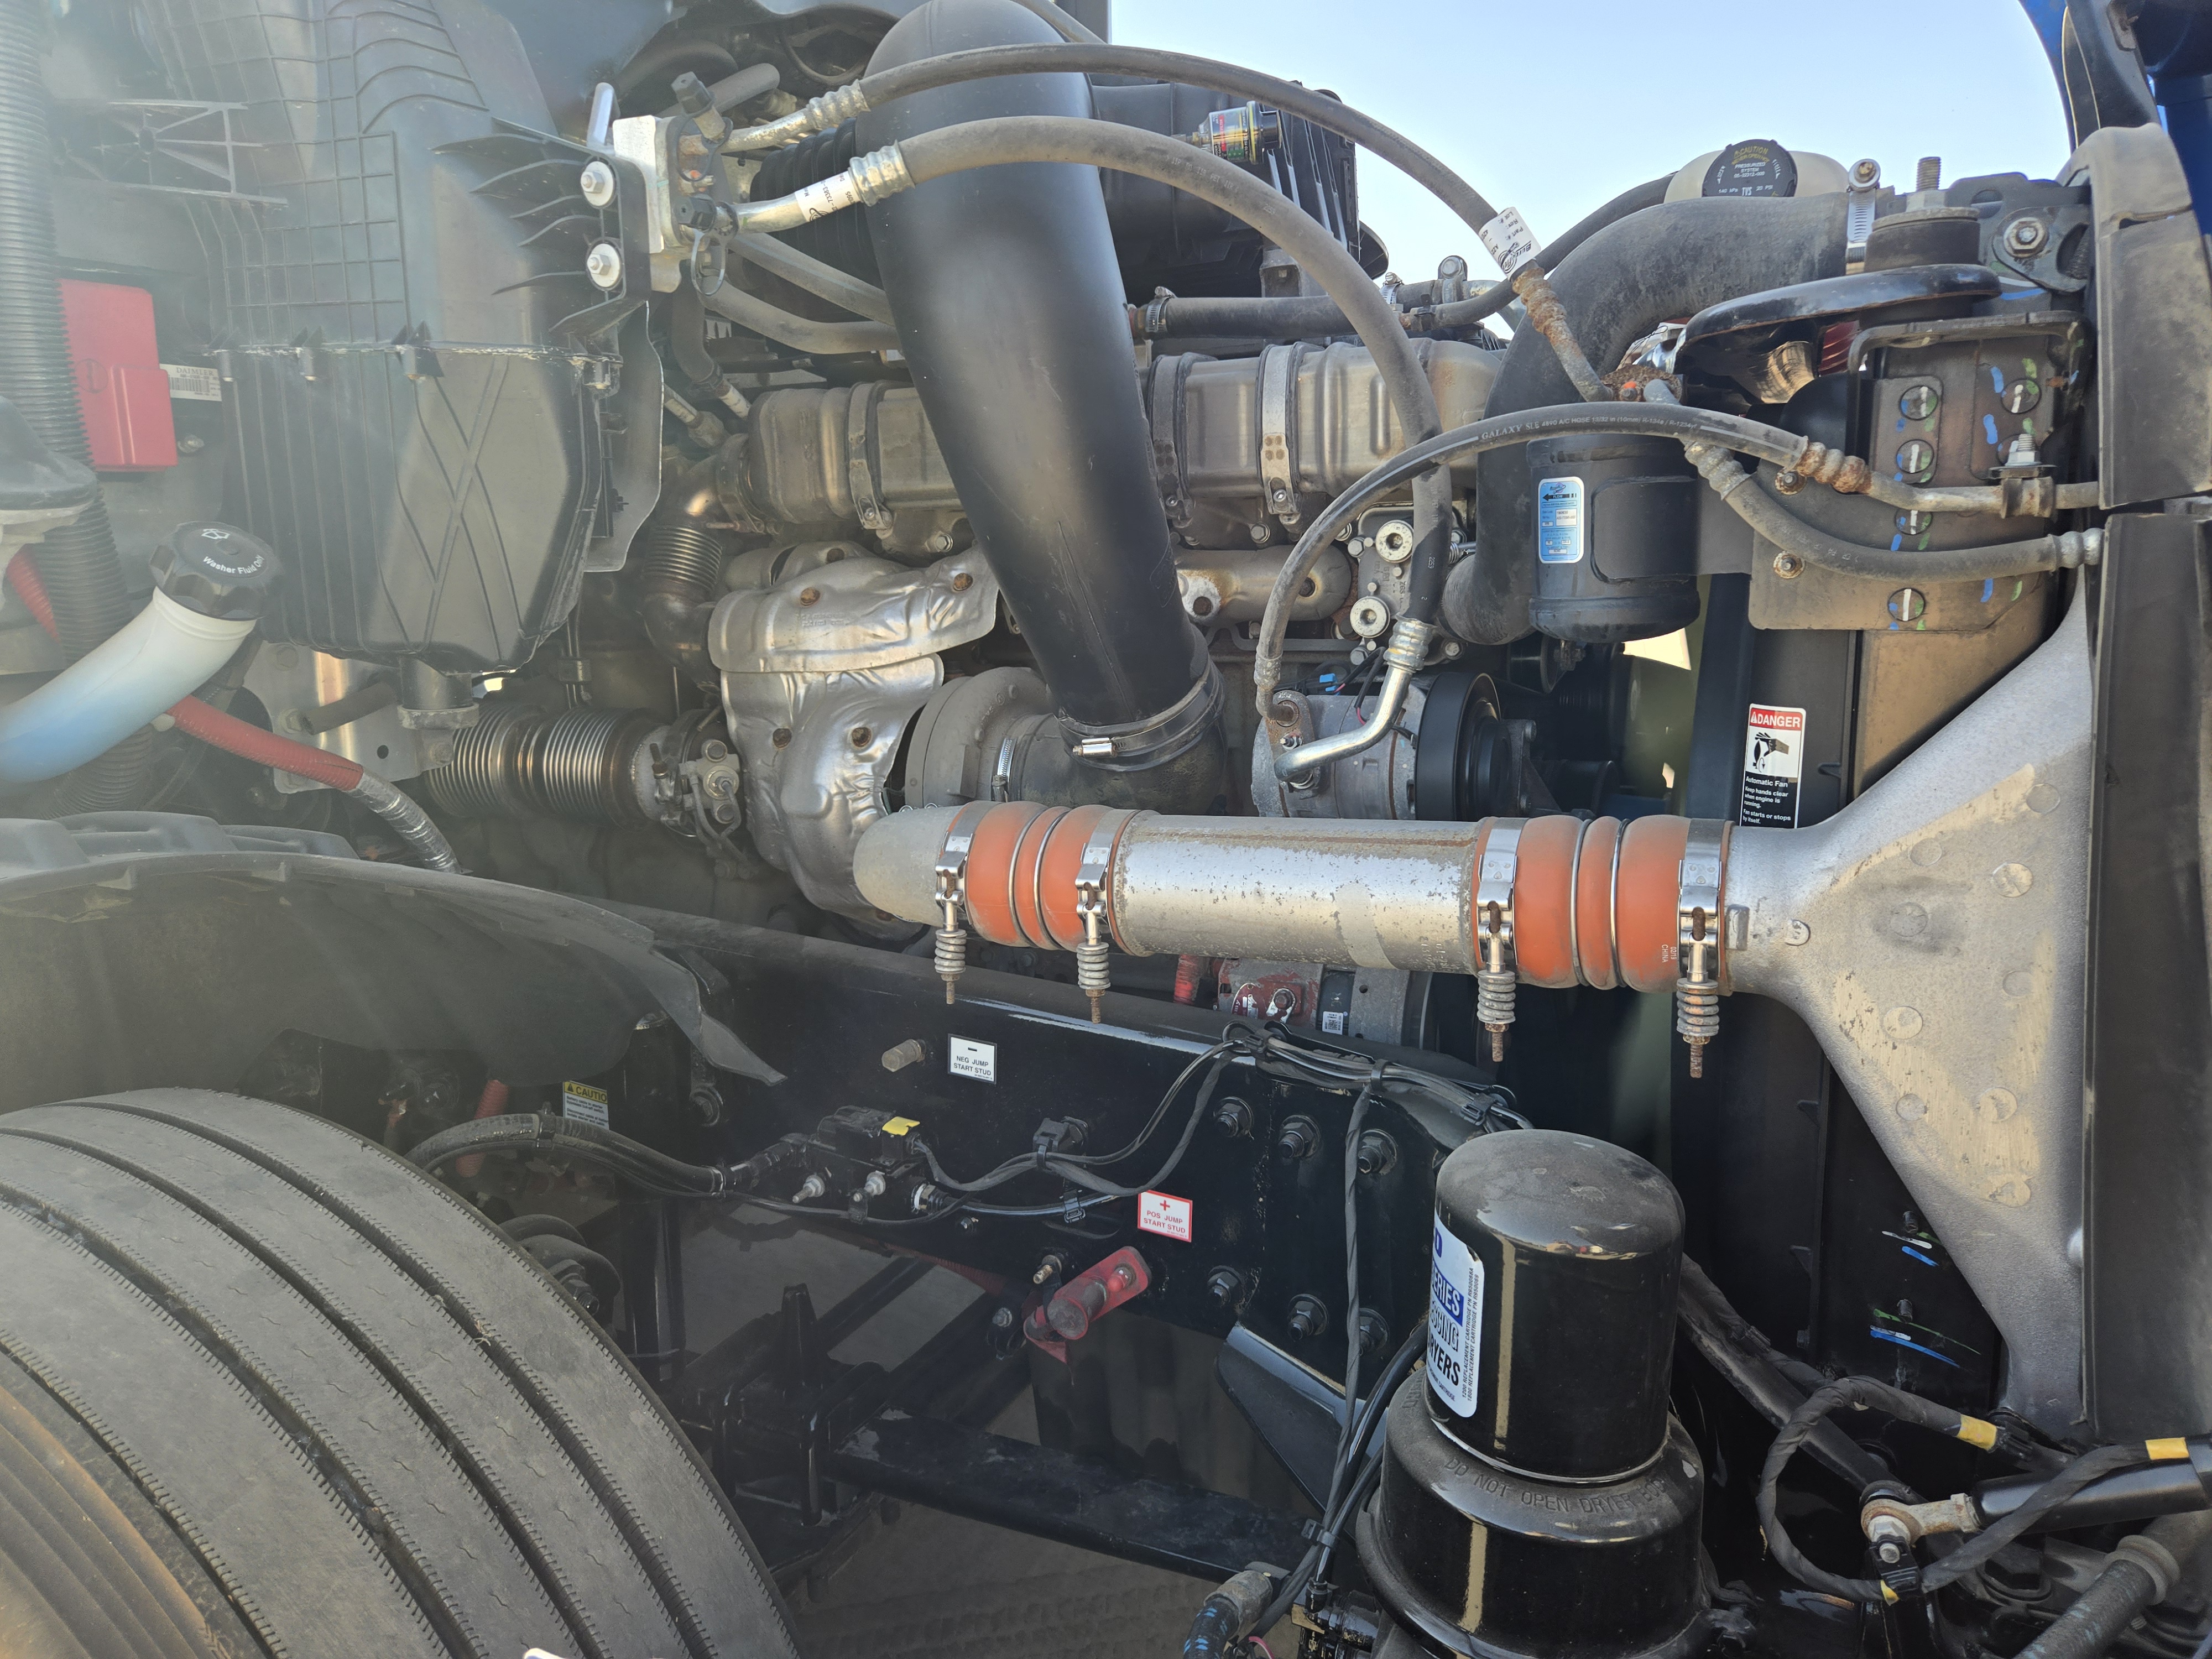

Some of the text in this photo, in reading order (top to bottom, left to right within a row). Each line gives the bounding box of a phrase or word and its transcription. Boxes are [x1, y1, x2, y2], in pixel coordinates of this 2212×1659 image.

[1740, 146, 1769, 155] CAUTION
[1742, 186, 1752, 196] TVS
[1504, 211, 1514, 220] Lot
[1511, 226, 1524, 237] Part
[176, 367, 215, 376] DAIMLER
[1481, 424, 1523, 440] GALAXY
[1525, 421, 1540, 430] SLE
[203, 555, 265, 574] Washer Fluid Only
[1757, 714, 1801, 728] DANGER
[1746, 776, 1773, 786] Automatic
[1744, 800, 1761, 808] running.
[953, 1063, 992, 1076] START STUD
[576, 1086, 607, 1102] CAUTIO
[1147, 1210, 1183, 1224] POS JUMP
[1144, 1218, 1186, 1233] START STUD
[1467, 1298, 1472, 1307] PN
[1473, 1301, 1478, 1310] PN
[1444, 1458, 1468, 1477] DO
[1474, 1474, 1510, 1497] NOT
[1521, 1491, 1569, 1512] OPEN
[1578, 1493, 1635, 1513] DRYER
